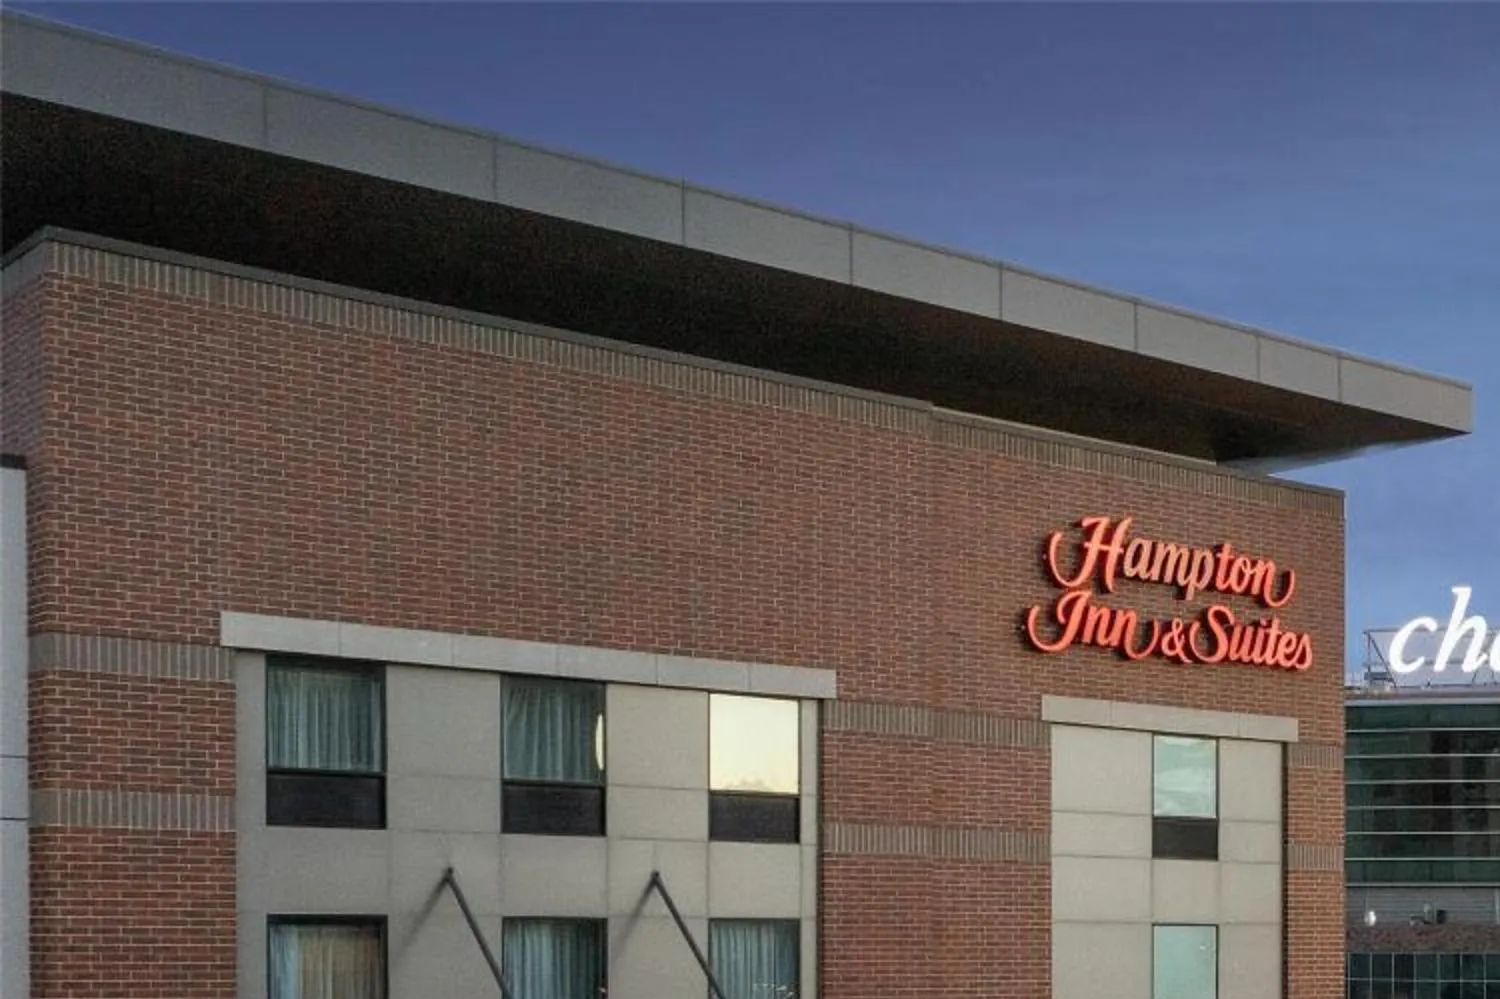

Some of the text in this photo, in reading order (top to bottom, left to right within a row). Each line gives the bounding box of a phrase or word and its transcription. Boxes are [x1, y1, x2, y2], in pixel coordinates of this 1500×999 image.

[1046, 515, 1297, 609] Hampton
[1026, 588, 1314, 672] Inn & Suites
